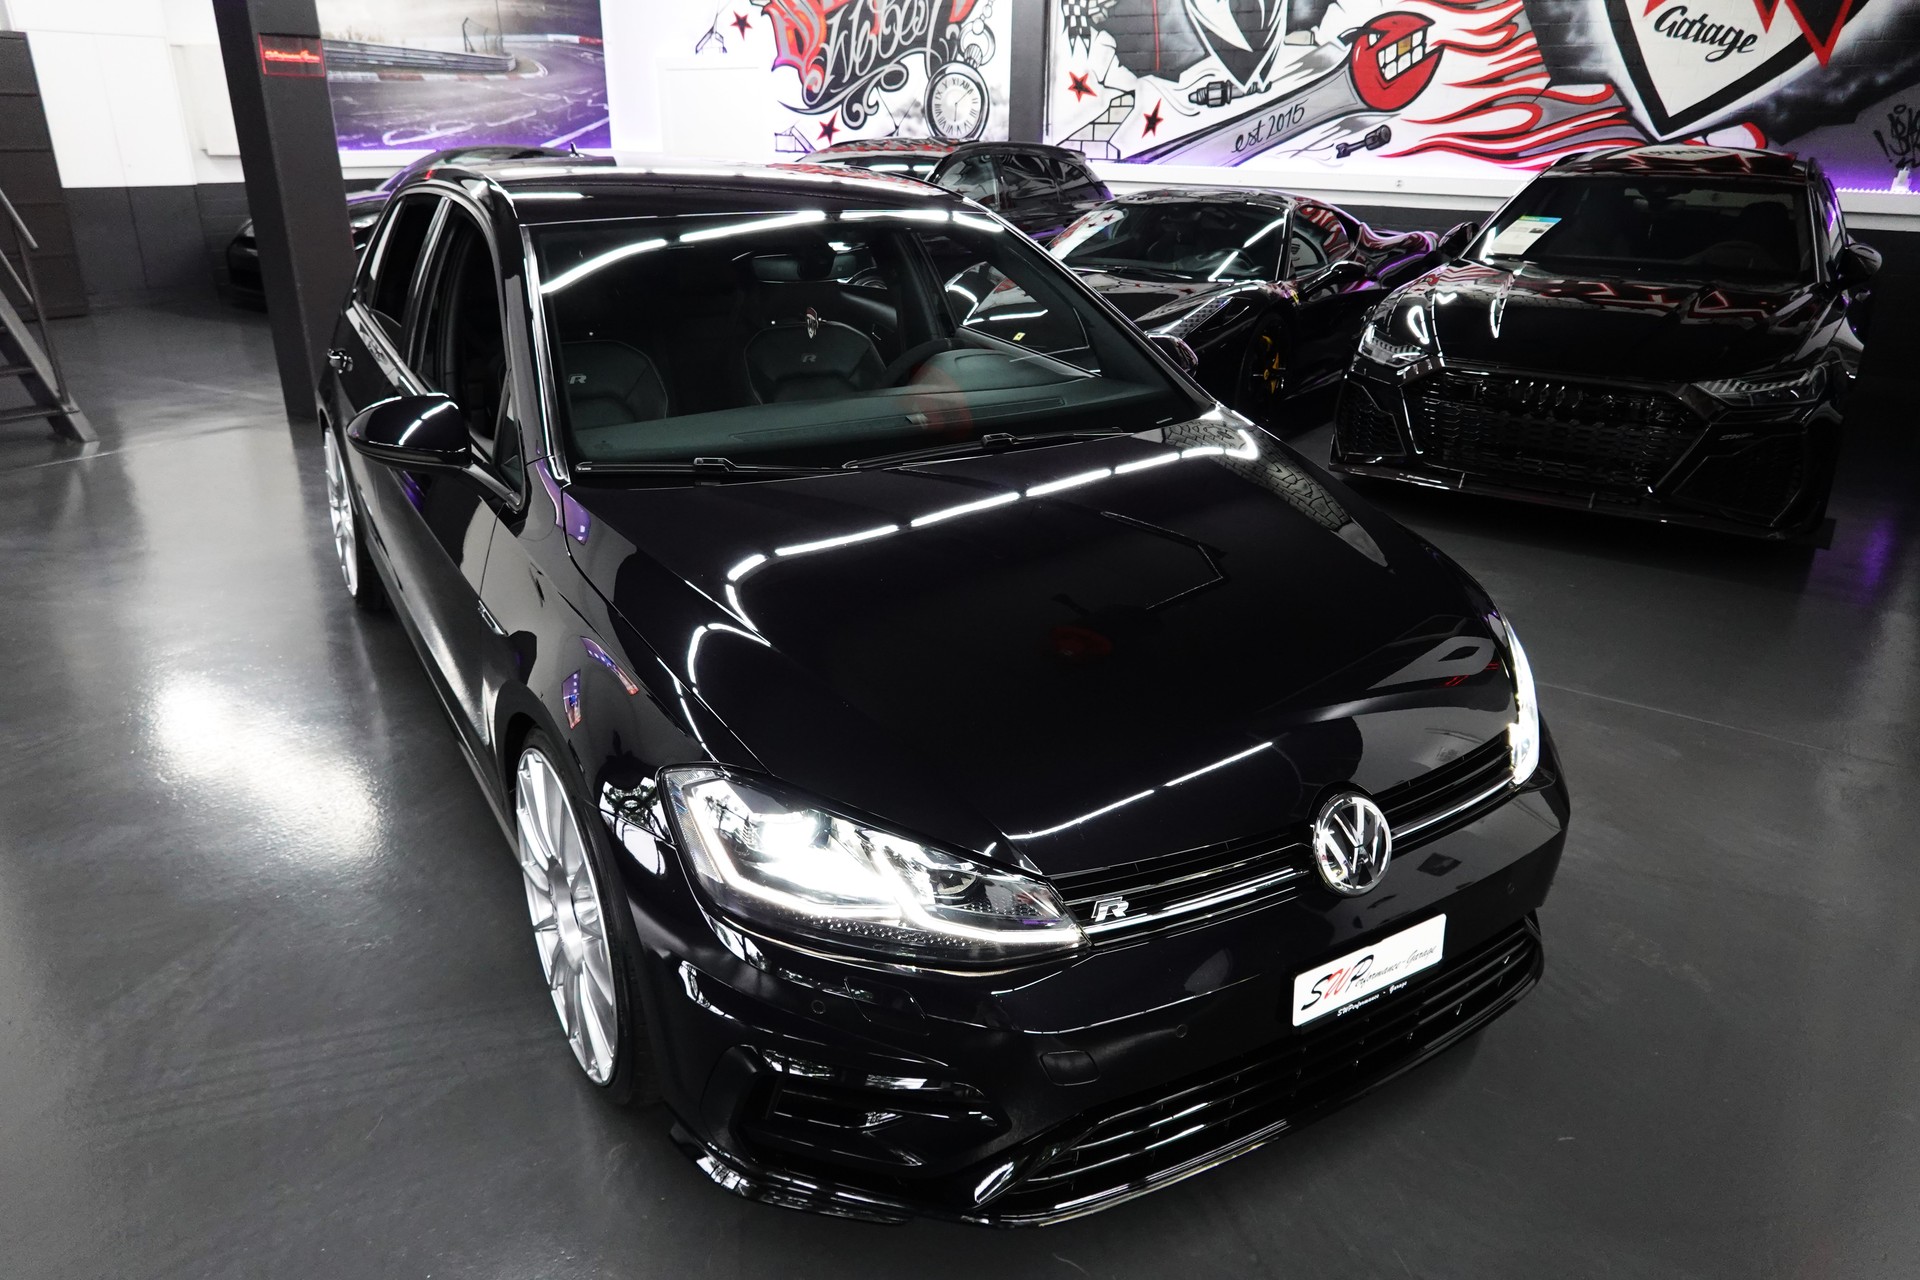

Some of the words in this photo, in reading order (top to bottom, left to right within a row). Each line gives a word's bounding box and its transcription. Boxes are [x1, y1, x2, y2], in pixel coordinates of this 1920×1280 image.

[1654, 4, 1758, 62] Garage
[1231, 120, 1265, 153] est
[1266, 98, 1309, 140] 2015
[569, 374, 587, 384] R
[1091, 896, 1130, 922] R
